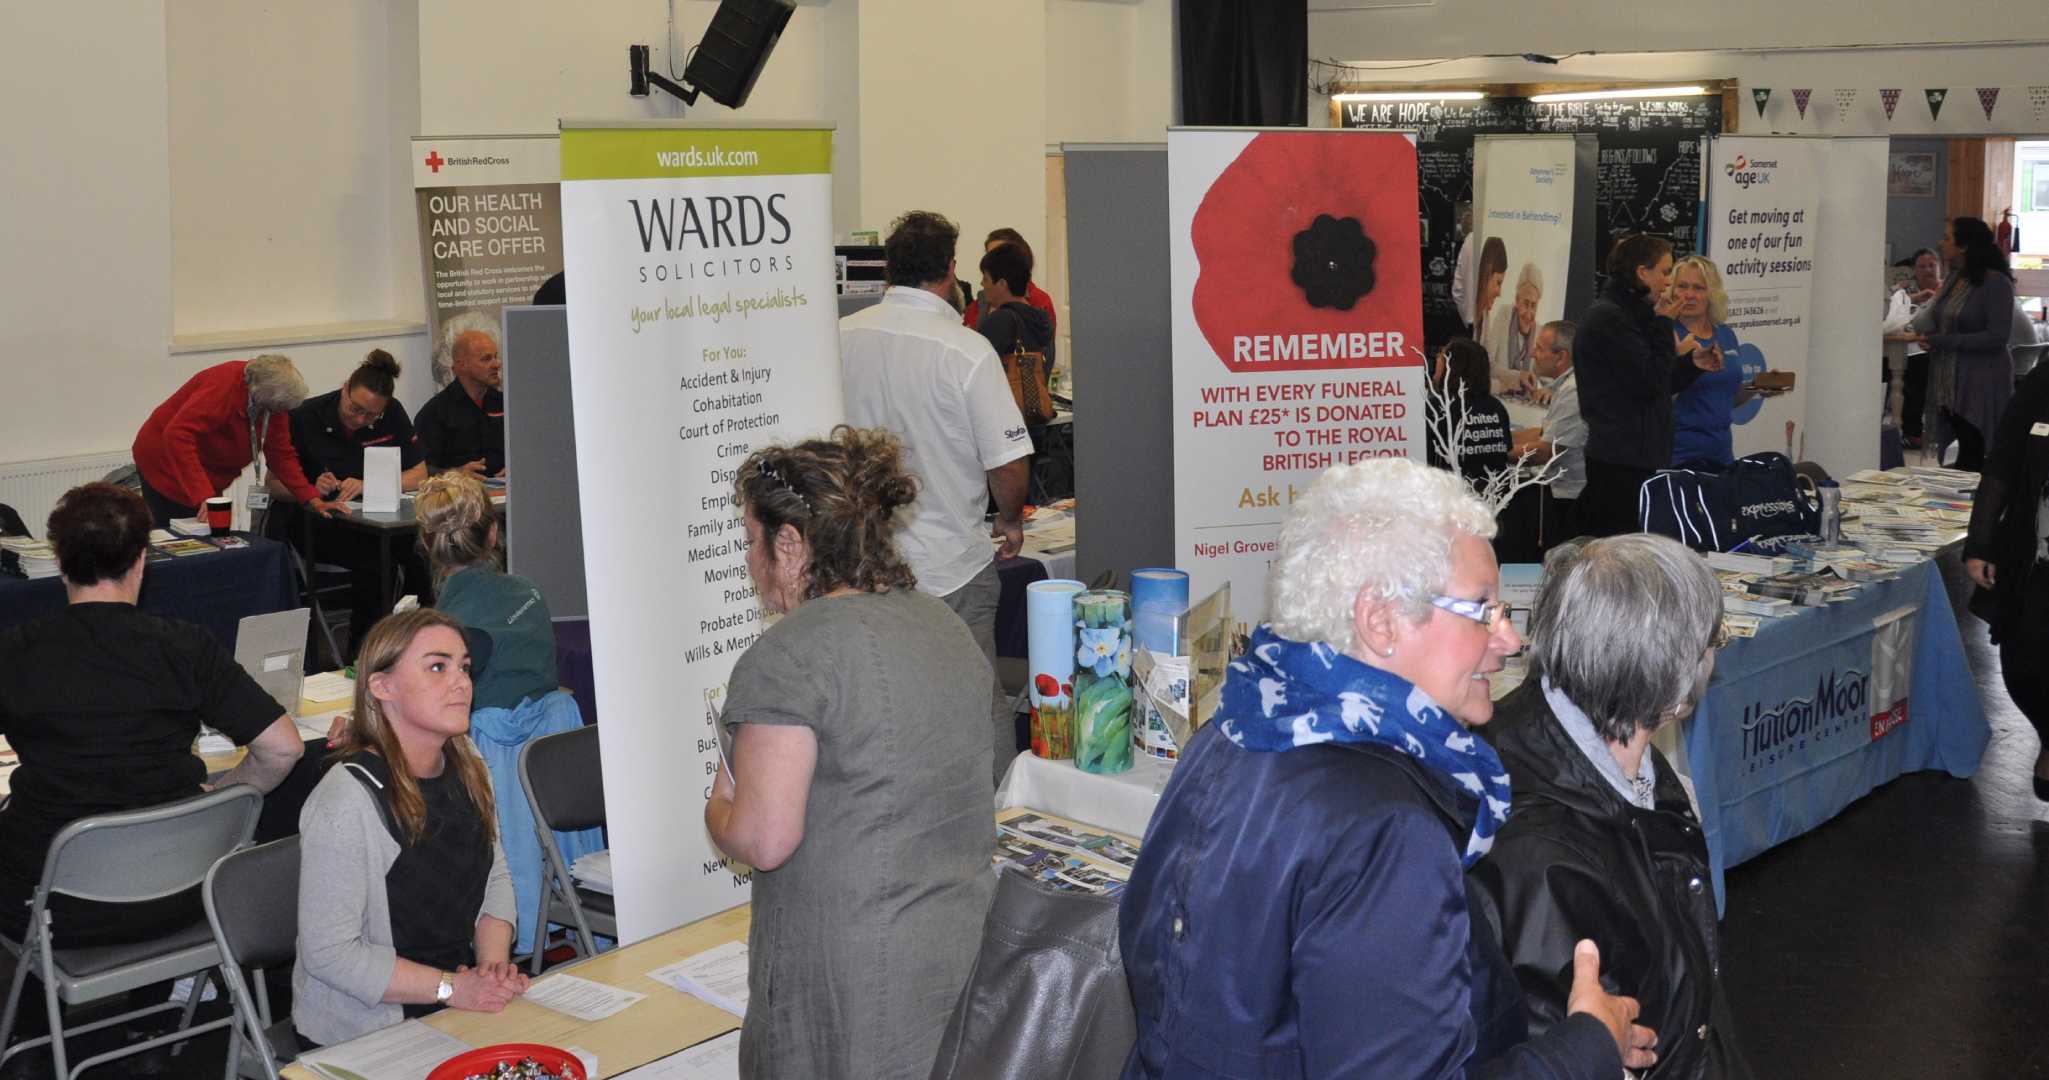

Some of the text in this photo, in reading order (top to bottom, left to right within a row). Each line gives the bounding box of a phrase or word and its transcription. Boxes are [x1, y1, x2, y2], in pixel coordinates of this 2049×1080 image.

[1348, 103, 1367, 122] WE
[1371, 103, 1394, 123] ARE
[1399, 102, 1431, 123] HOPE
[656, 145, 758, 168] wards.uk.com
[429, 193, 543, 214] OUR HEALTH
[431, 215, 540, 236] AND SOCIAL
[627, 193, 792, 253] WARDS
[1728, 207, 1804, 228] Get moving at
[433, 236, 545, 259] CARE OFFER
[1728, 231, 1802, 253] one of our fun
[640, 255, 793, 283] SOLICITORS
[1726, 256, 1812, 278] activity sessions
[665, 296, 694, 320] local
[698, 291, 731, 324] legal
[735, 285, 808, 317] specialists
[703, 346, 747, 362] For You:
[1233, 331, 1405, 363] REMEMBER
[680, 367, 771, 390] Accident & Injury
[693, 392, 762, 413] Cohabitation
[1201, 380, 1406, 404] WITH EVERY FUNERAL
[679, 413, 780, 440] Court of Protection
[1193, 410, 1243, 428] PLAN
[1296, 406, 1311, 423] IS
[1317, 403, 1406, 422] DONATED
[1465, 412, 1499, 425] United
[1274, 426, 1407, 448] TO THE ROYAL
[1464, 427, 1504, 442] Against
[717, 442, 749, 458] Crime
[1263, 452, 1332, 471] BRITISH
[1238, 485, 1280, 508] Ask
[688, 519, 724, 537] Family
[688, 540, 731, 563] Medical
[1194, 541, 1230, 559] Nigel
[704, 563, 747, 584] Moving
[700, 612, 743, 634] Probate
[685, 644, 711, 664] Wills
[713, 641, 723, 655] &
[703, 857, 728, 876] New
